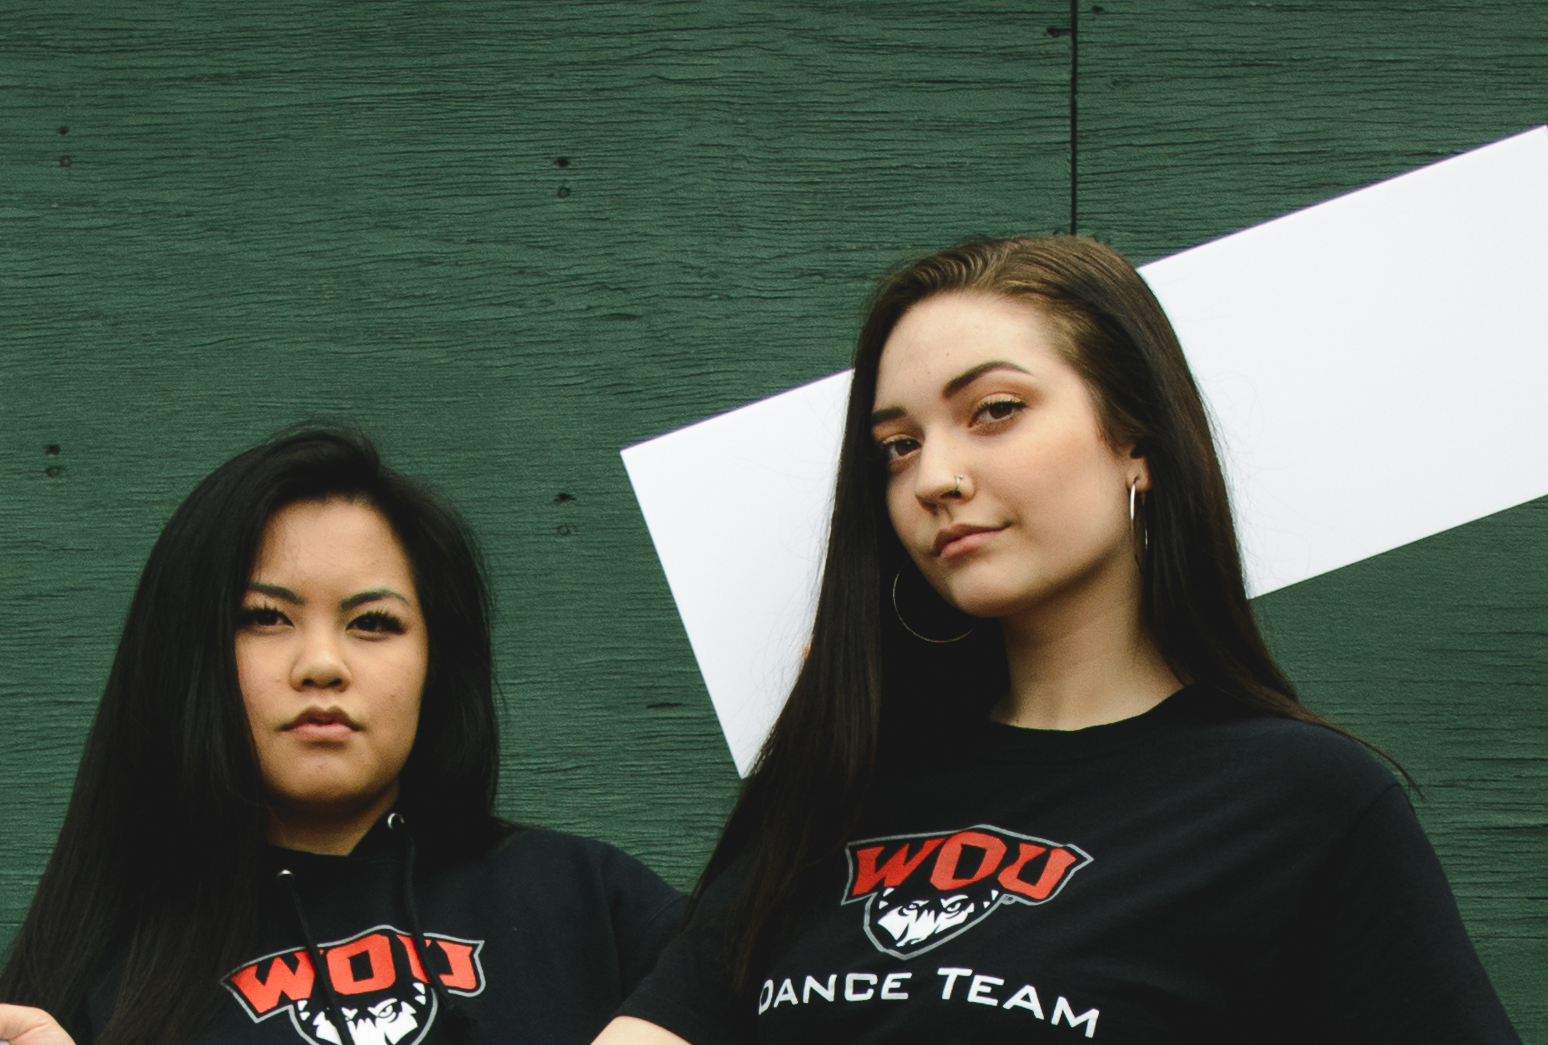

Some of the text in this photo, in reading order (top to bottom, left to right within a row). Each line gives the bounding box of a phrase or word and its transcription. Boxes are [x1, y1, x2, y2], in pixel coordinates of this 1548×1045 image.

[852, 831, 1077, 900] WOU
[231, 933, 477, 1014] WOU
[758, 967, 1100, 1038] DANCE TEAM
